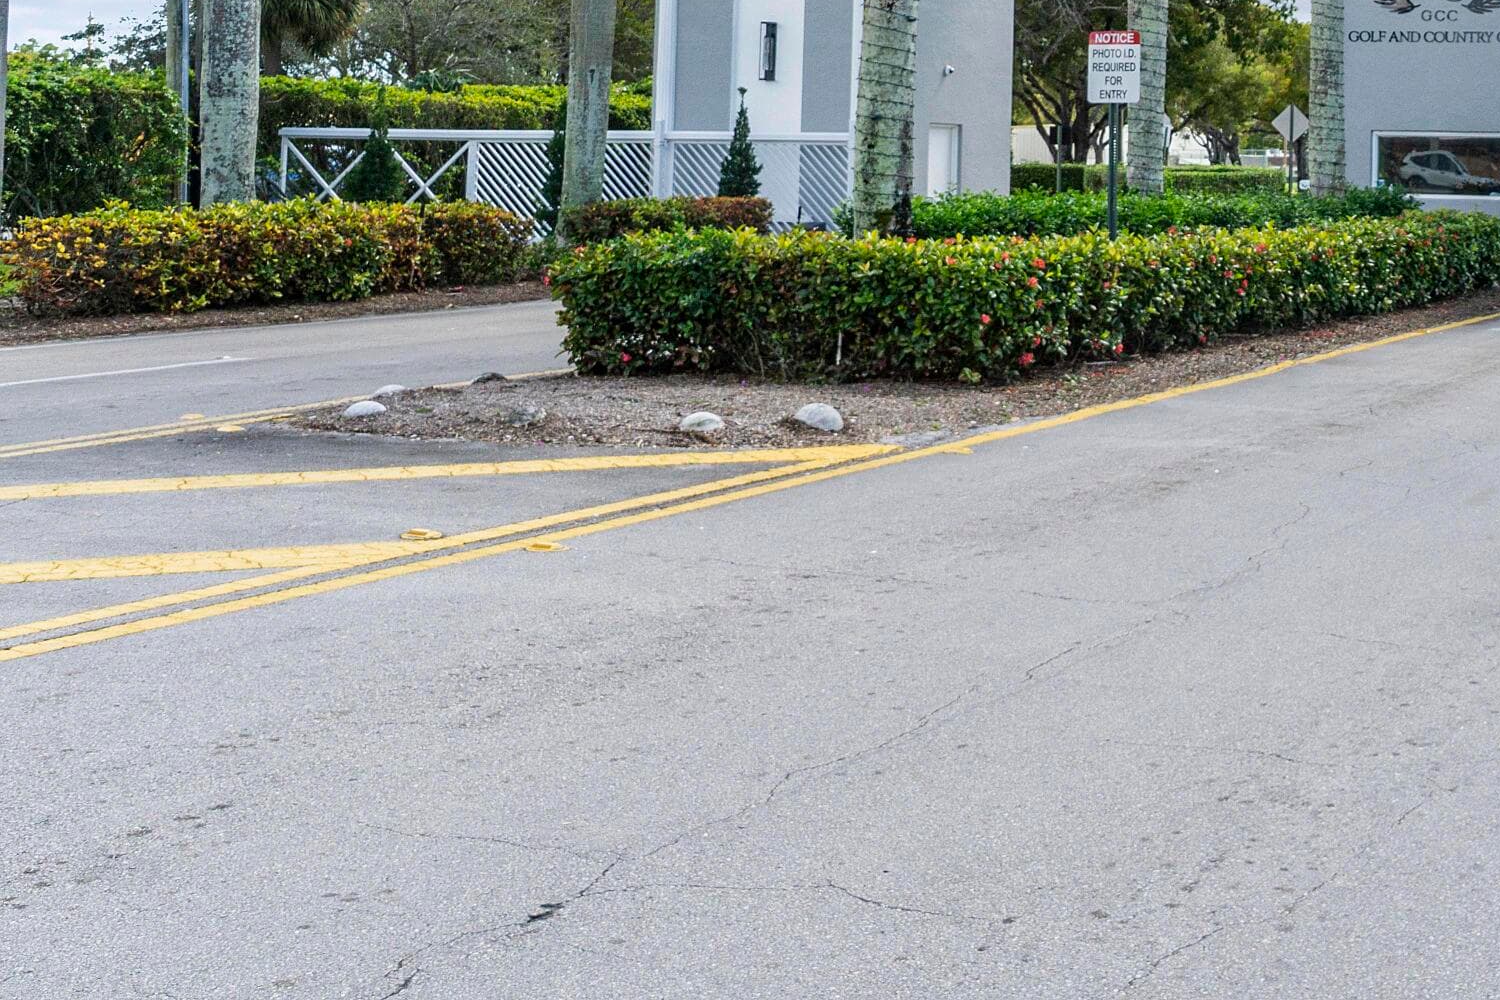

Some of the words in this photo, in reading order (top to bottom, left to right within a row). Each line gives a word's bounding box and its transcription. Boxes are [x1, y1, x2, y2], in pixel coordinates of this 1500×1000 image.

[1421, 9, 1459, 22] GCC
[1094, 33, 1135, 43] NOTICE
[1348, 30, 1387, 43] GOLF
[1389, 30, 1421, 43] AND
[1424, 31, 1493, 43] COUNTRY
[1092, 48, 1122, 58] PHOTO
[1092, 62, 1136, 72] REQUIRED
[1104, 75, 1123, 85] FOR
[1099, 89, 1128, 99] ENTRY
